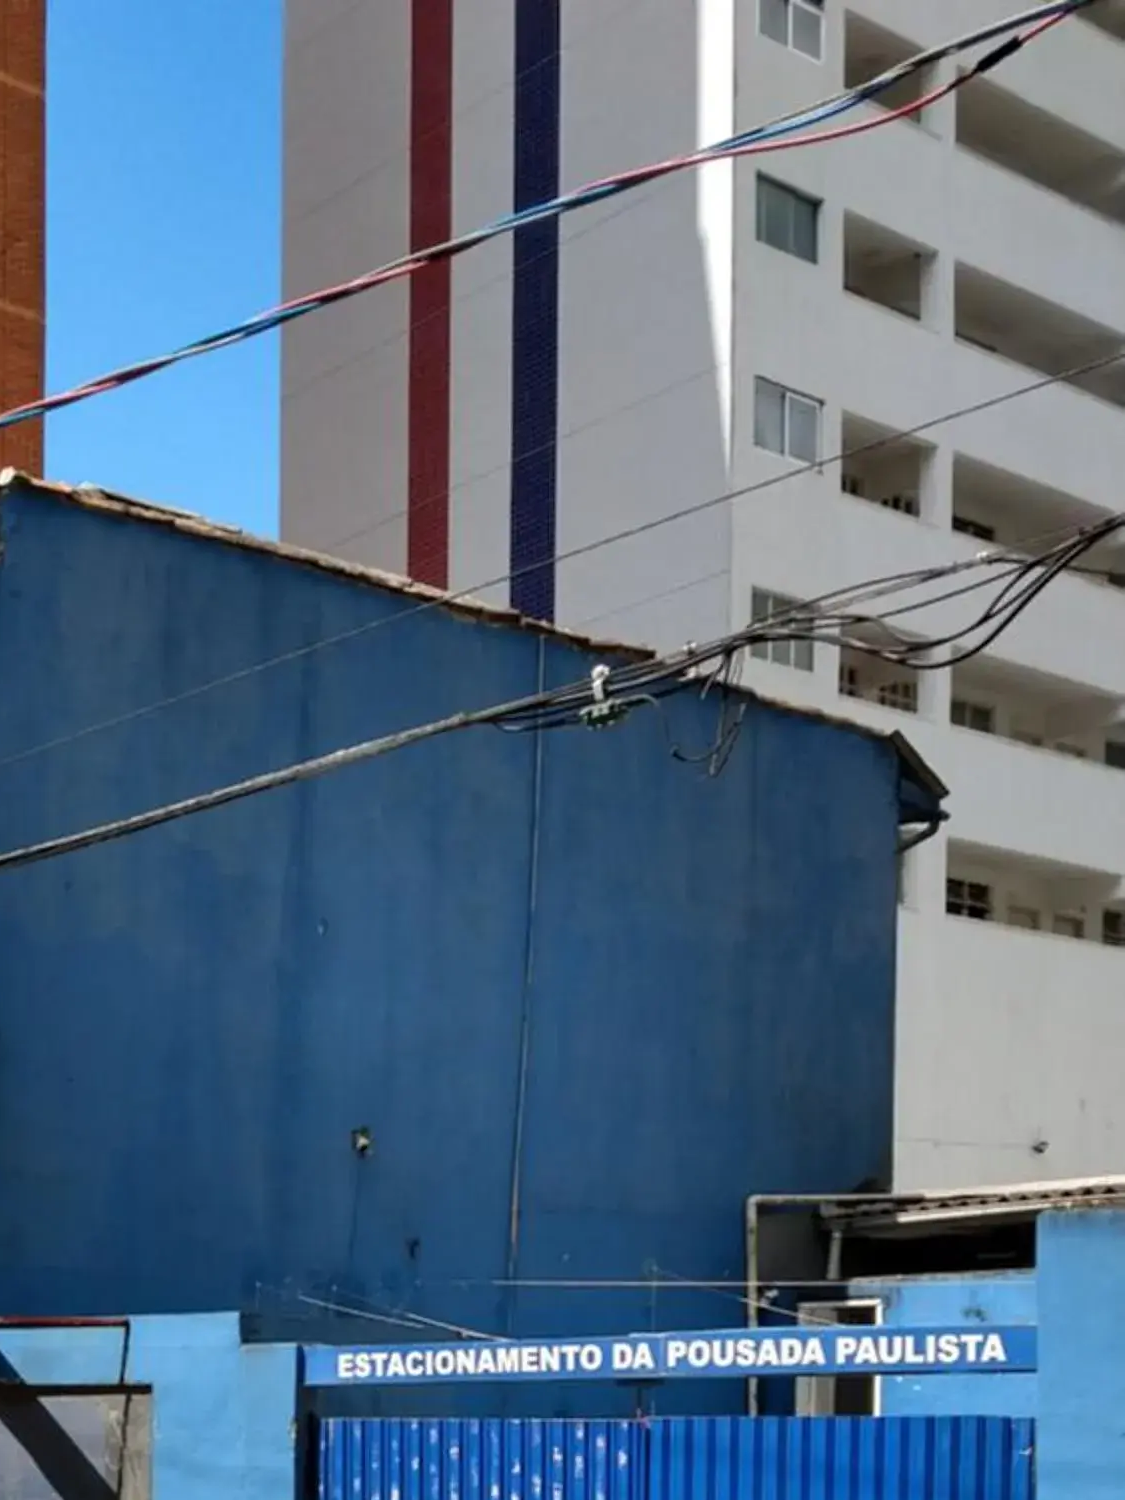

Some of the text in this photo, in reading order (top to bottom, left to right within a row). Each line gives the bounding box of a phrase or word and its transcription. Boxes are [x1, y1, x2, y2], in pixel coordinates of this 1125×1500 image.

[337, 1333, 1007, 1378] ESTACIONAMENTO DA POUSADA PAULISTA
